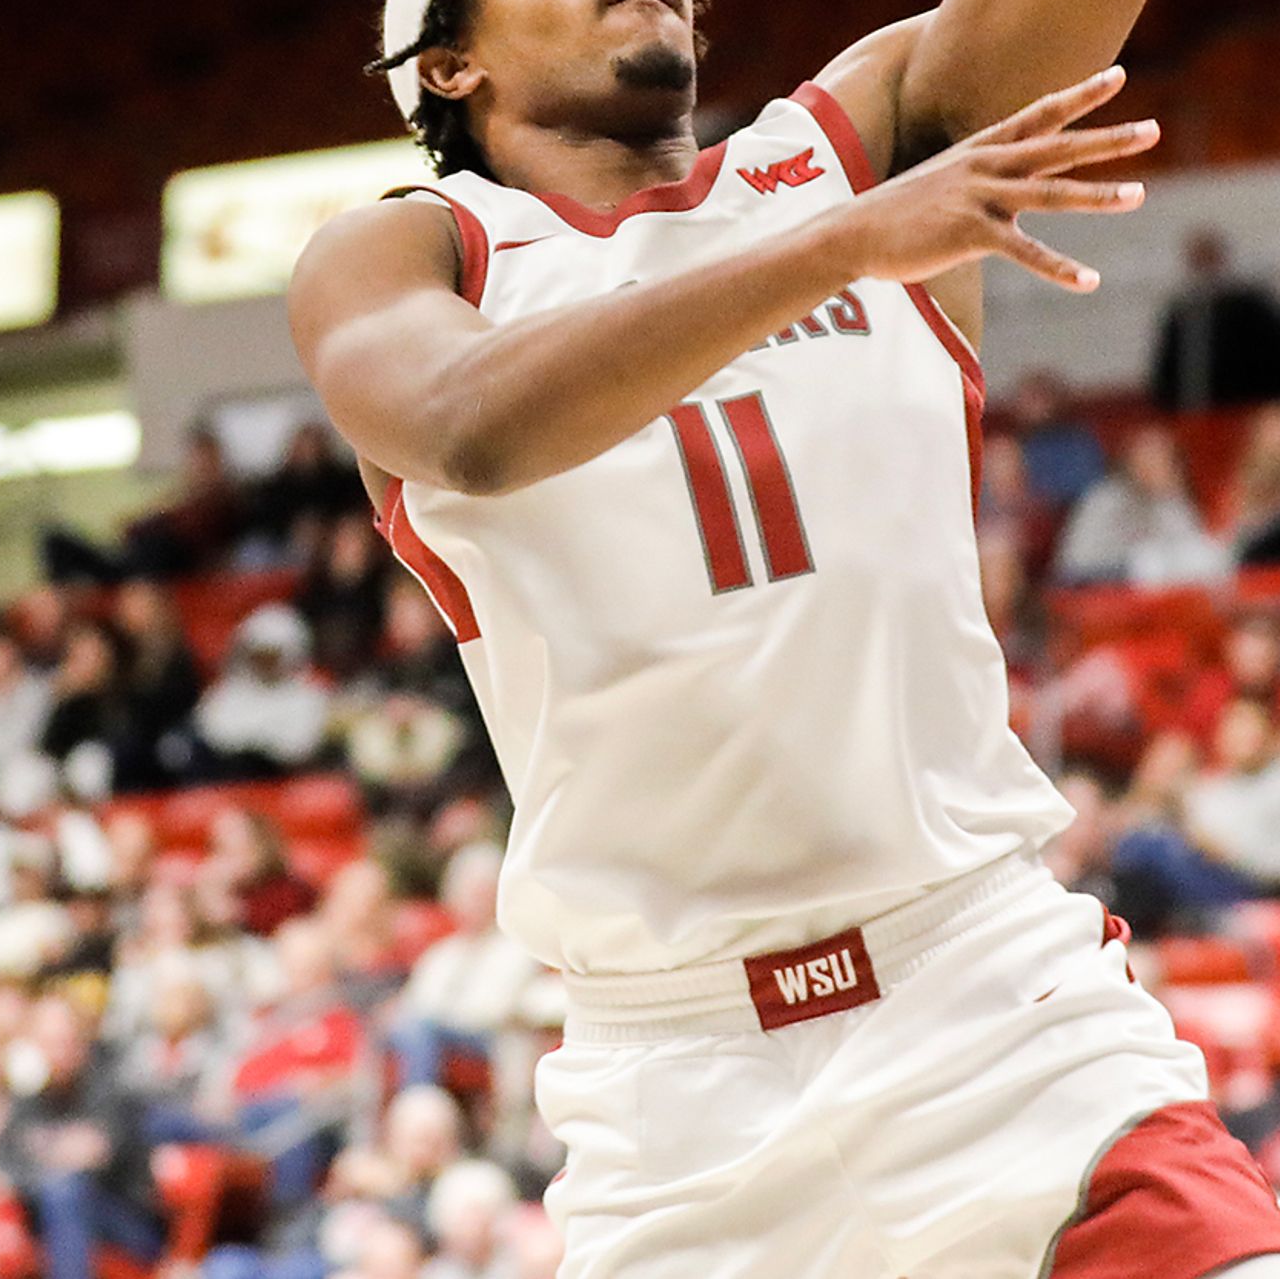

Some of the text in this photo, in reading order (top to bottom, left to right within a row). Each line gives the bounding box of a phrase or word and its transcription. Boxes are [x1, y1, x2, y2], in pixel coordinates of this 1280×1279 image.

[736, 146, 826, 195] WCC
[666, 389, 816, 596] 11
[773, 948, 857, 1005] WSU
